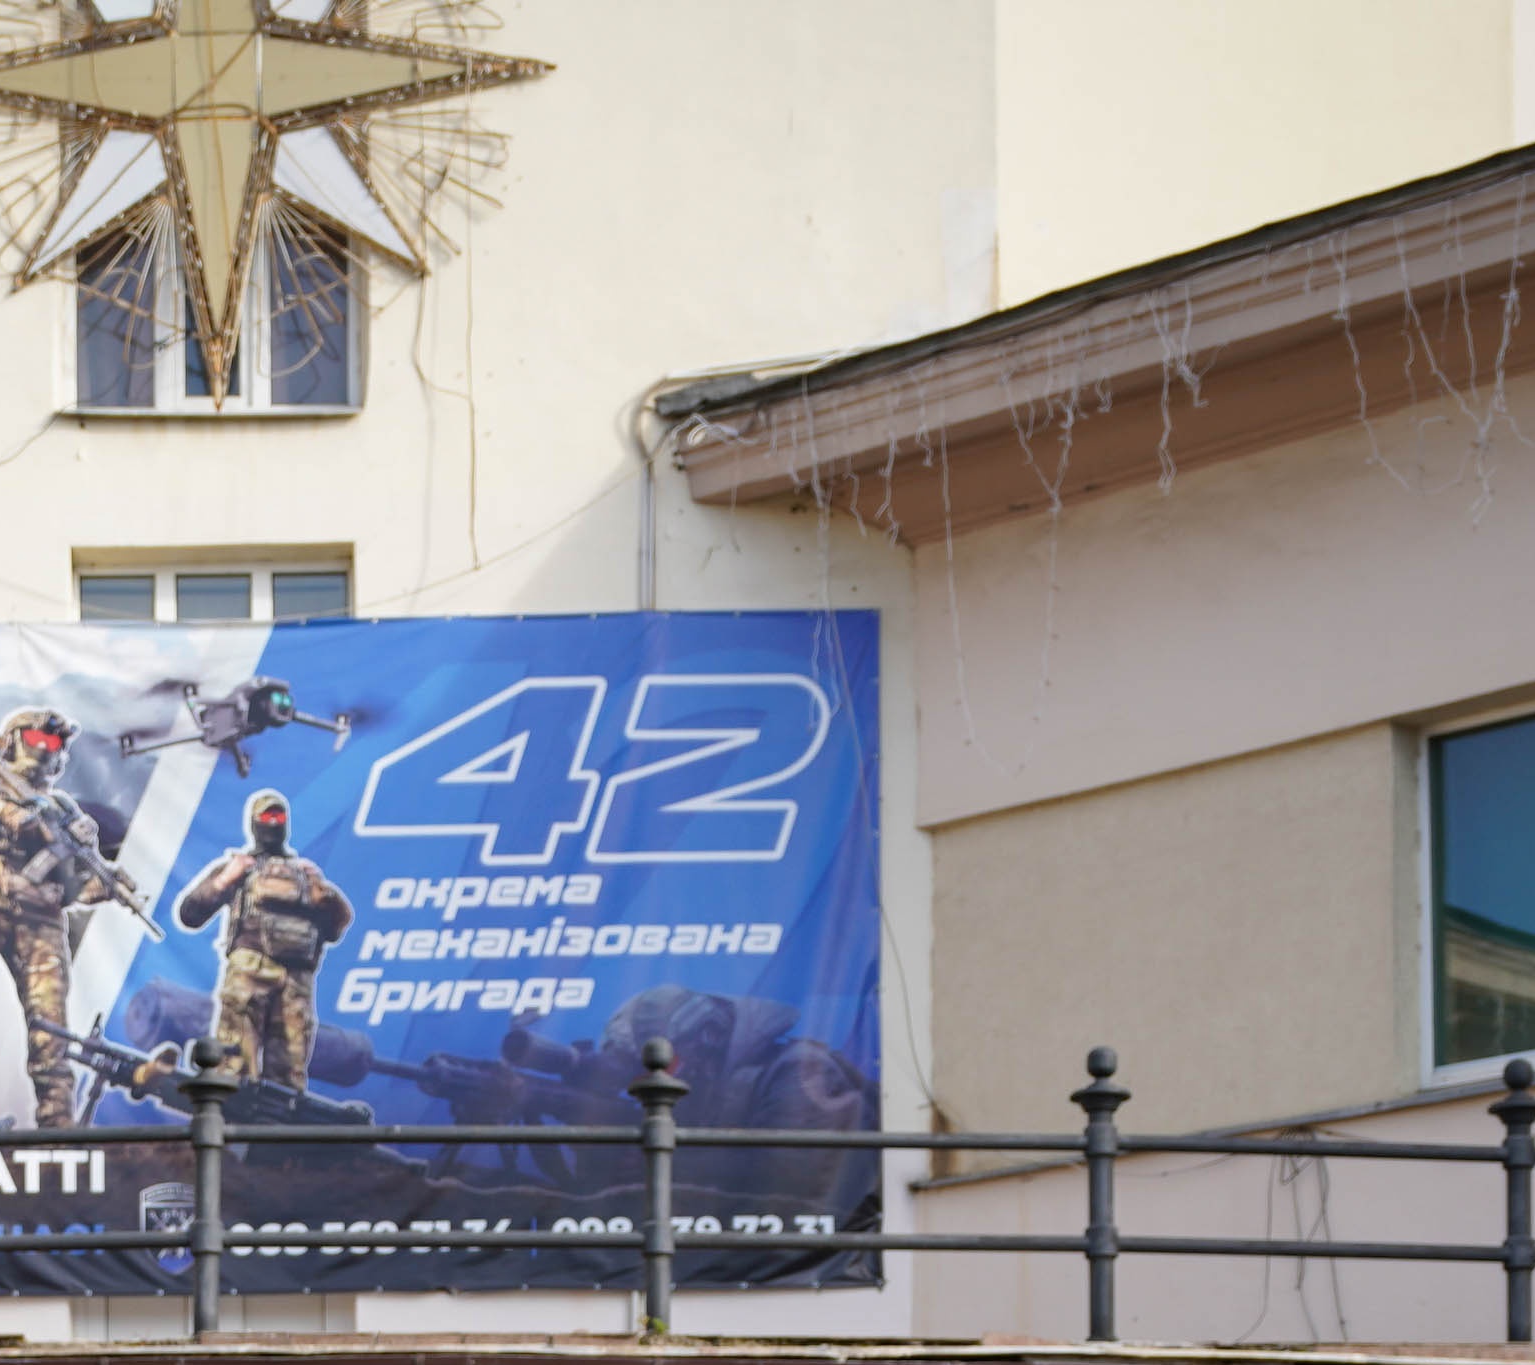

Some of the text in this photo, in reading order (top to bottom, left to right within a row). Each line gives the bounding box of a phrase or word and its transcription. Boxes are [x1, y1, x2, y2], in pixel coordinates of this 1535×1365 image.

[353, 674, 831, 867] 42
[374, 873, 603, 921] окрема
[358, 916, 784, 961] механізована
